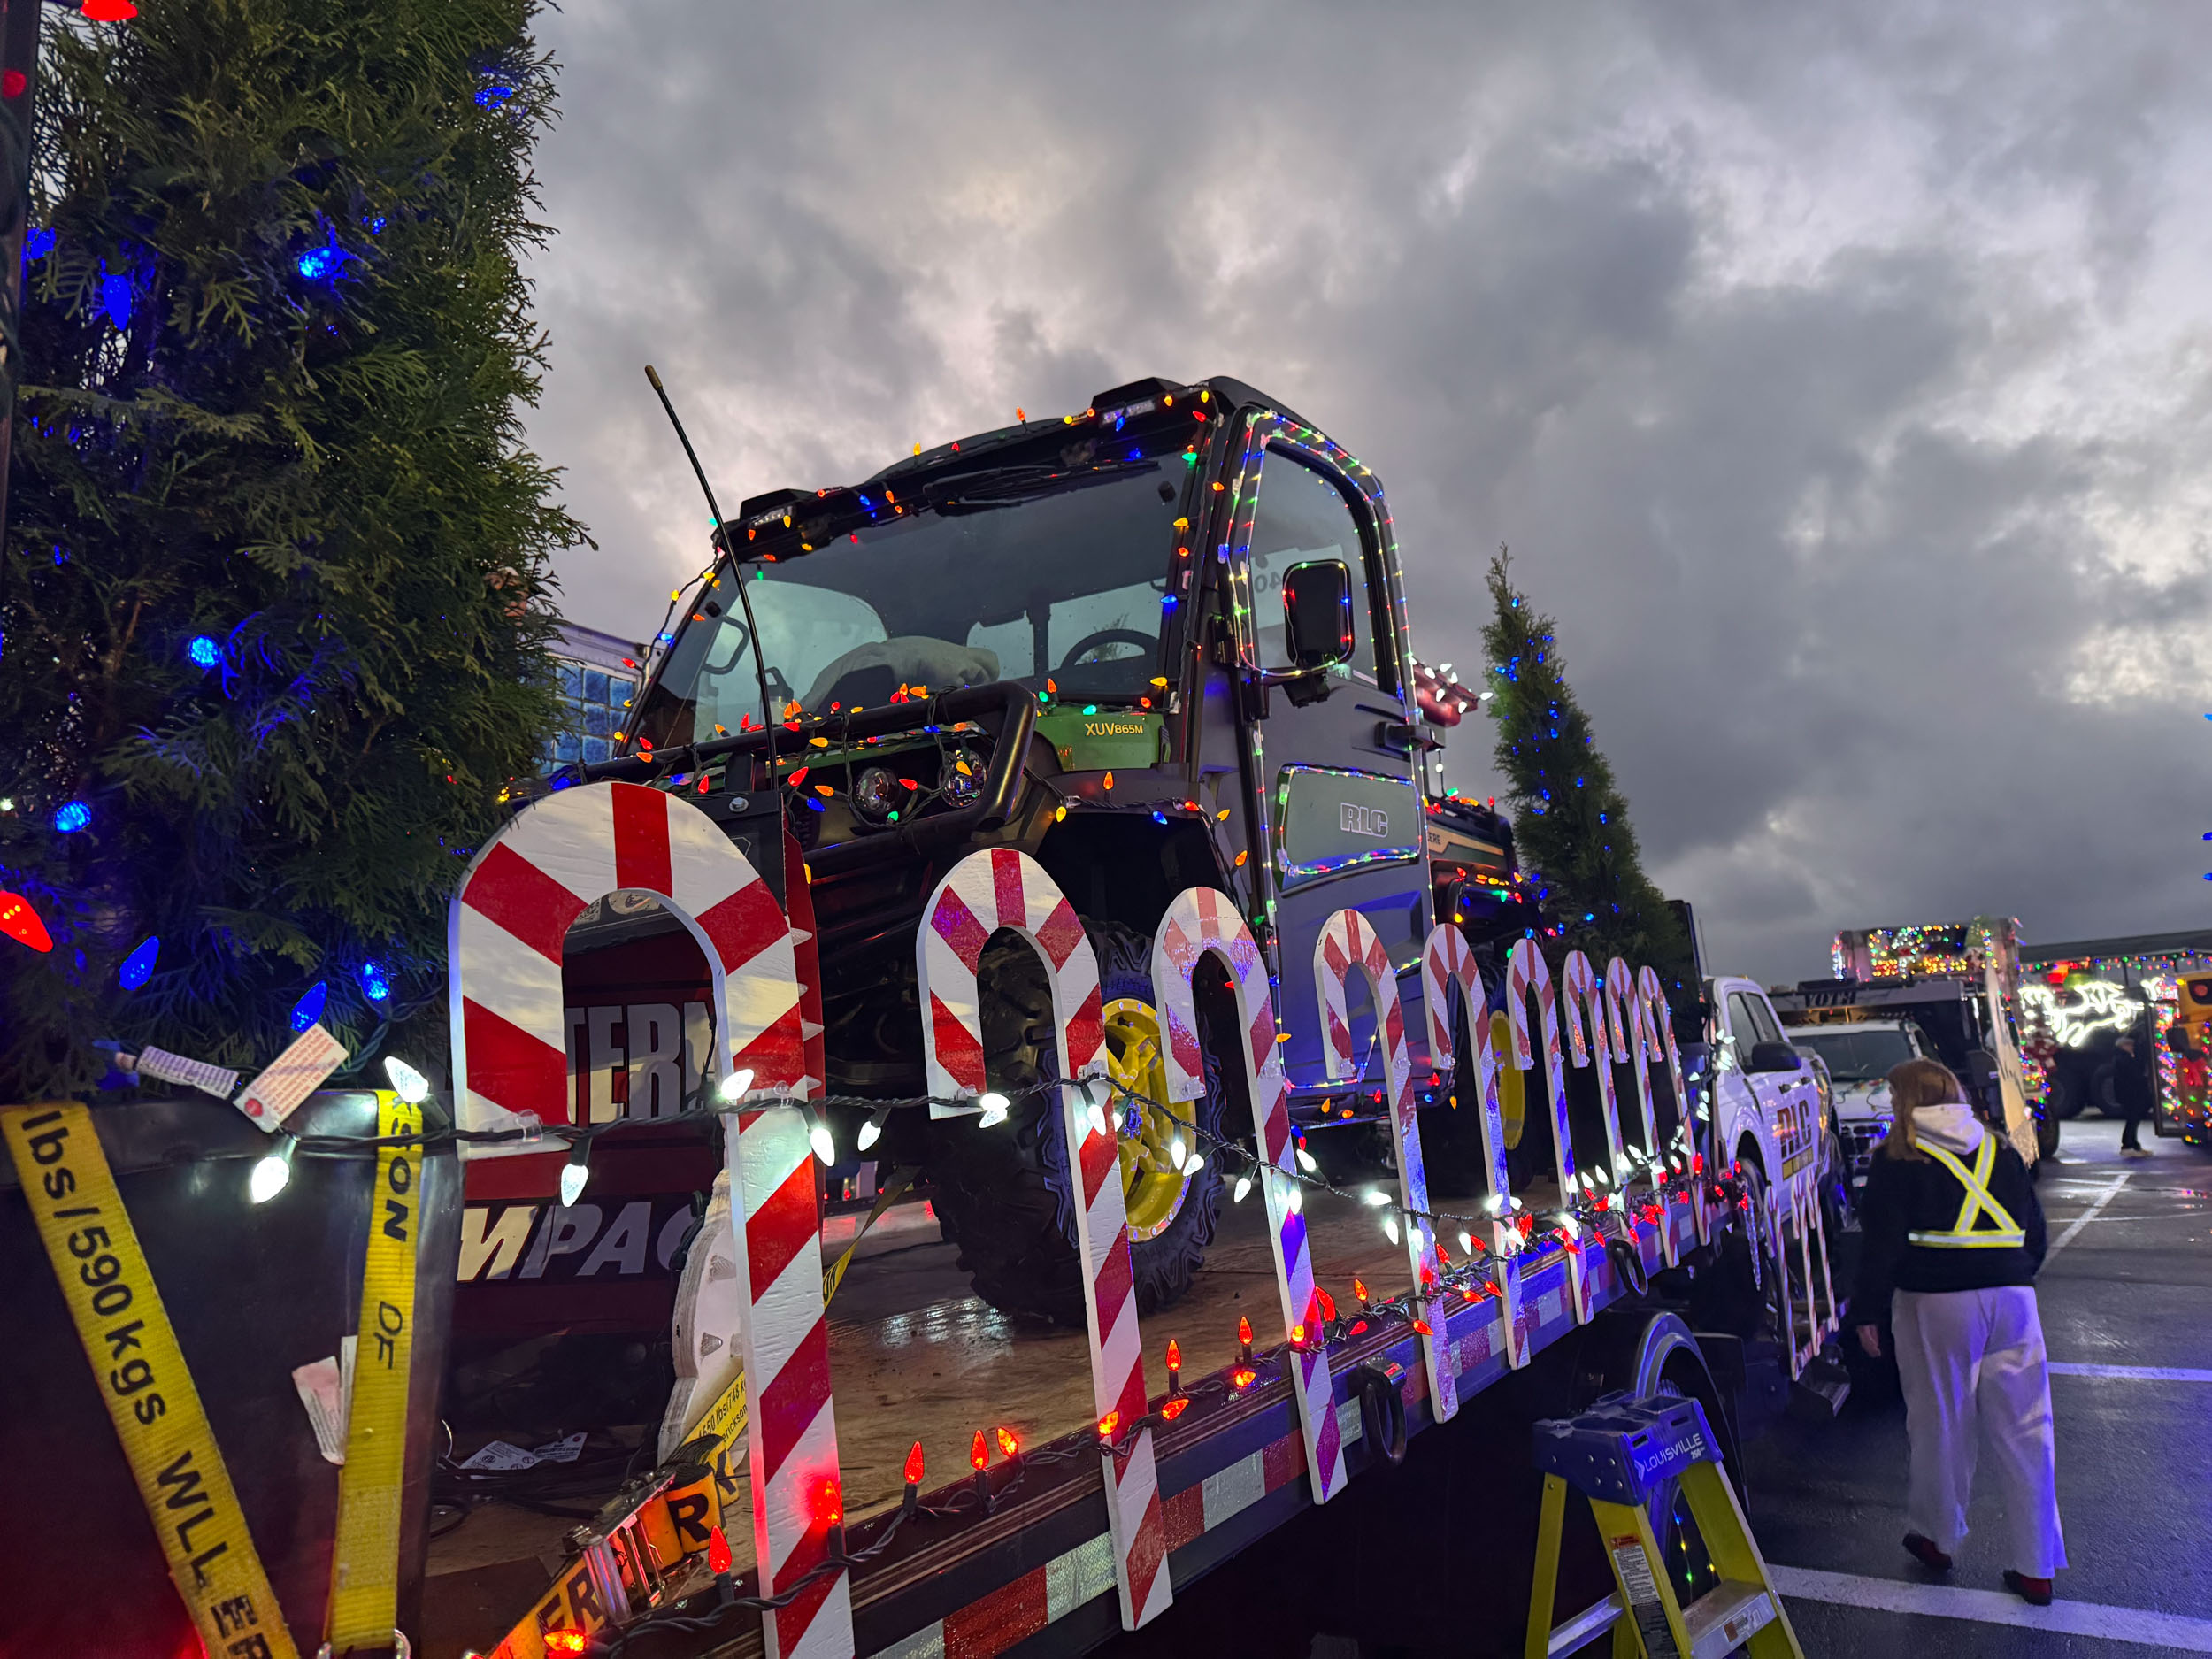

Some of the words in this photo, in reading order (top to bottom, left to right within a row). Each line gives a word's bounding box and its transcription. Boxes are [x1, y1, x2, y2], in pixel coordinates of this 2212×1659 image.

[1085, 722, 1143, 736] XUV865M
[1340, 803, 1388, 838] RLC
[1644, 1433, 1703, 1472] LOUISVILLE
[157, 1451, 228, 1589] WLL
